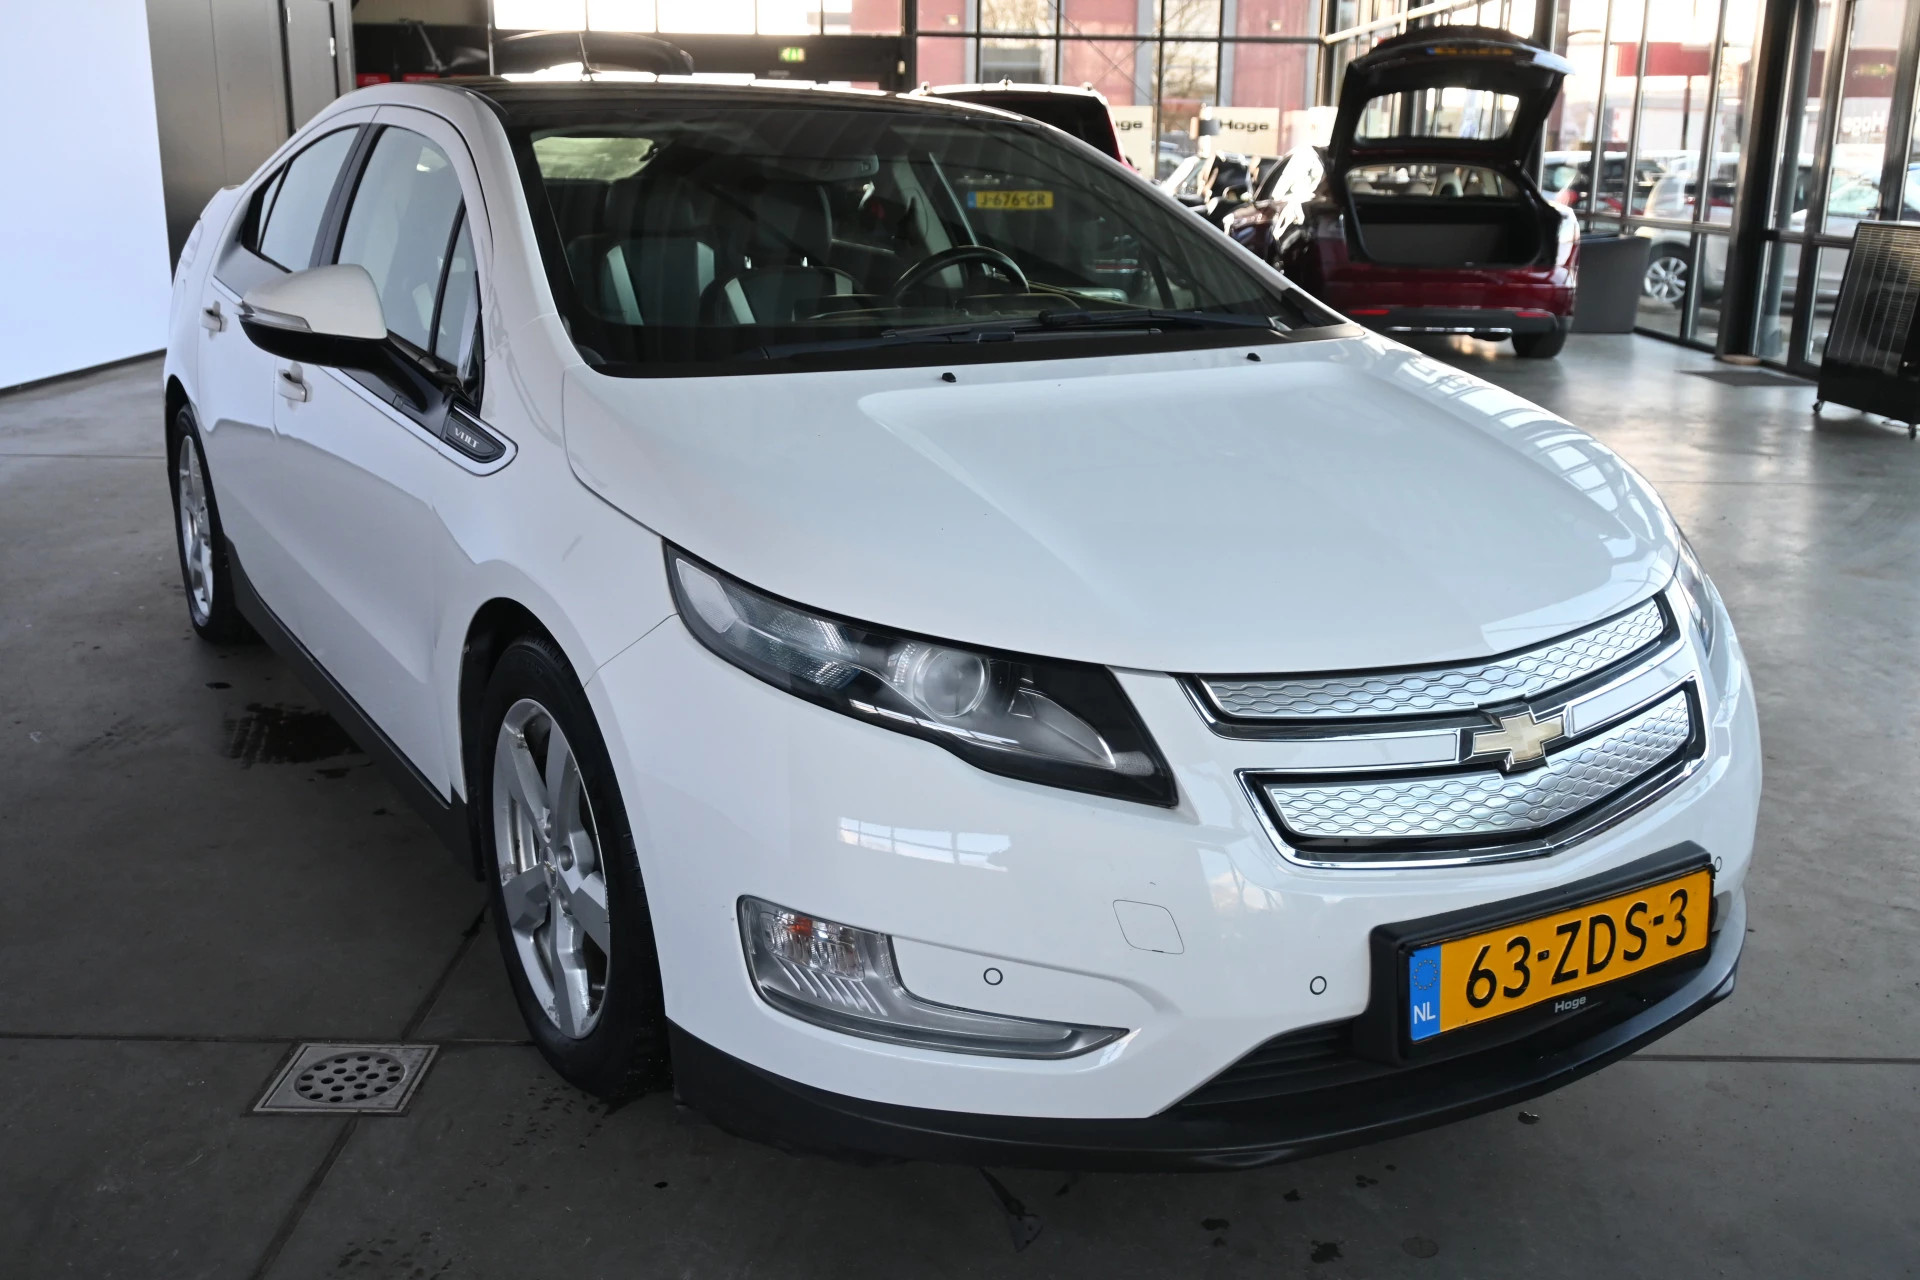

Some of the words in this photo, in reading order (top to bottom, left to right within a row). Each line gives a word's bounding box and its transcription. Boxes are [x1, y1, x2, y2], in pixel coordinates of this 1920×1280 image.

[1219, 119, 1269, 132] Hoge
[982, 192, 1046, 207] J-676-GR
[454, 427, 480, 448] VOLT
[1466, 888, 1689, 1009] 63-ZDS-3
[1413, 1001, 1436, 1025] NL
[1554, 996, 1587, 1013] Hoge
